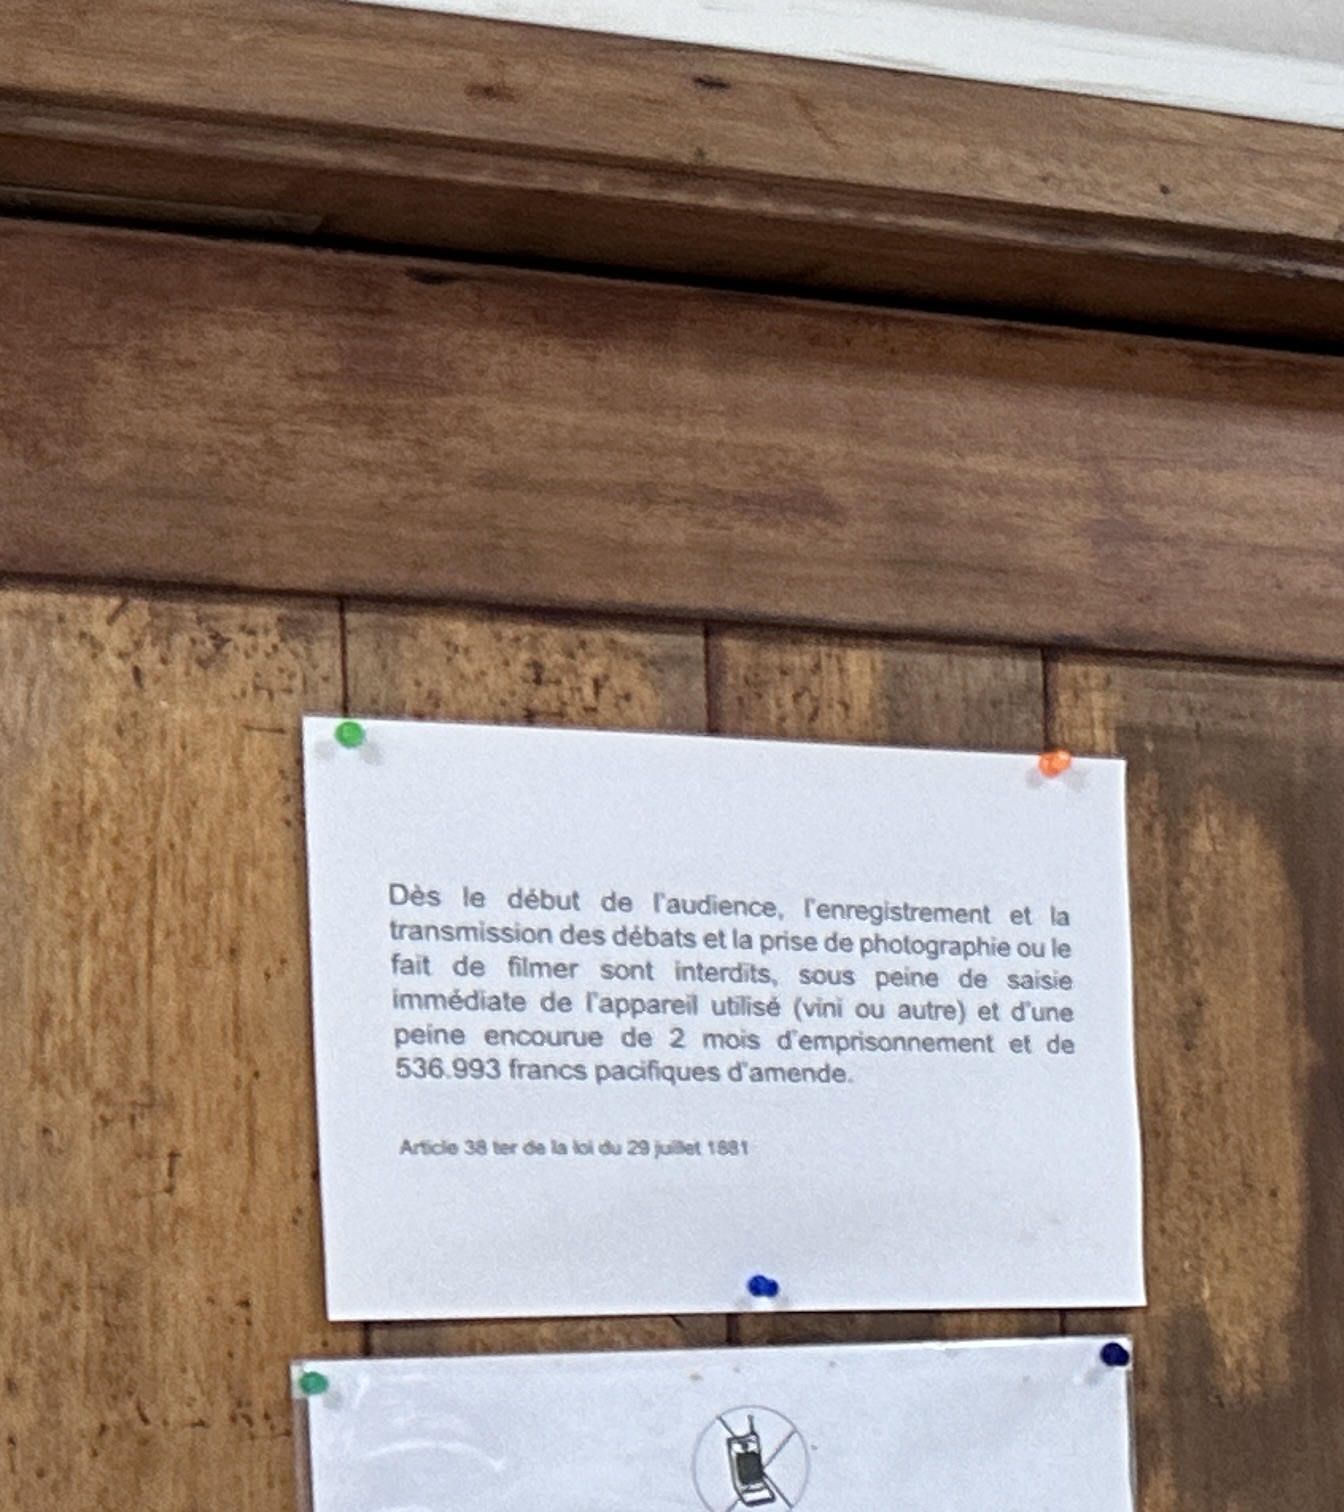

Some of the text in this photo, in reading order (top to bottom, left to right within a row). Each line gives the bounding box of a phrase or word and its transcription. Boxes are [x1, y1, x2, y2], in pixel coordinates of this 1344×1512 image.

[389, 883, 1069, 926] Dès le début de l'audience, l'enregistrement et la
[390, 920, 1071, 960] transmission des débats et la prise de photographie ou le
[391, 953, 1072, 991] fait de filmer sont interdits, sous peine de saisie
[392, 988, 1074, 1024] immédiate de l'appareil utilisé (vini ou autre) et d'une
[394, 1024, 1075, 1055] peine encourue de 2 mois d'emprisonnement et de
[396, 1057, 853, 1085] 536.993 francs pacifiques d'amende.
[401, 1139, 458, 1155] Article
[493, 1139, 517, 1155] ter
[522, 1139, 546, 1155] de
[551, 1139, 567, 1155] la
[573, 1139, 593, 1155] loi
[599, 1139, 622, 1155] du
[627, 1139, 649, 1155] 29
